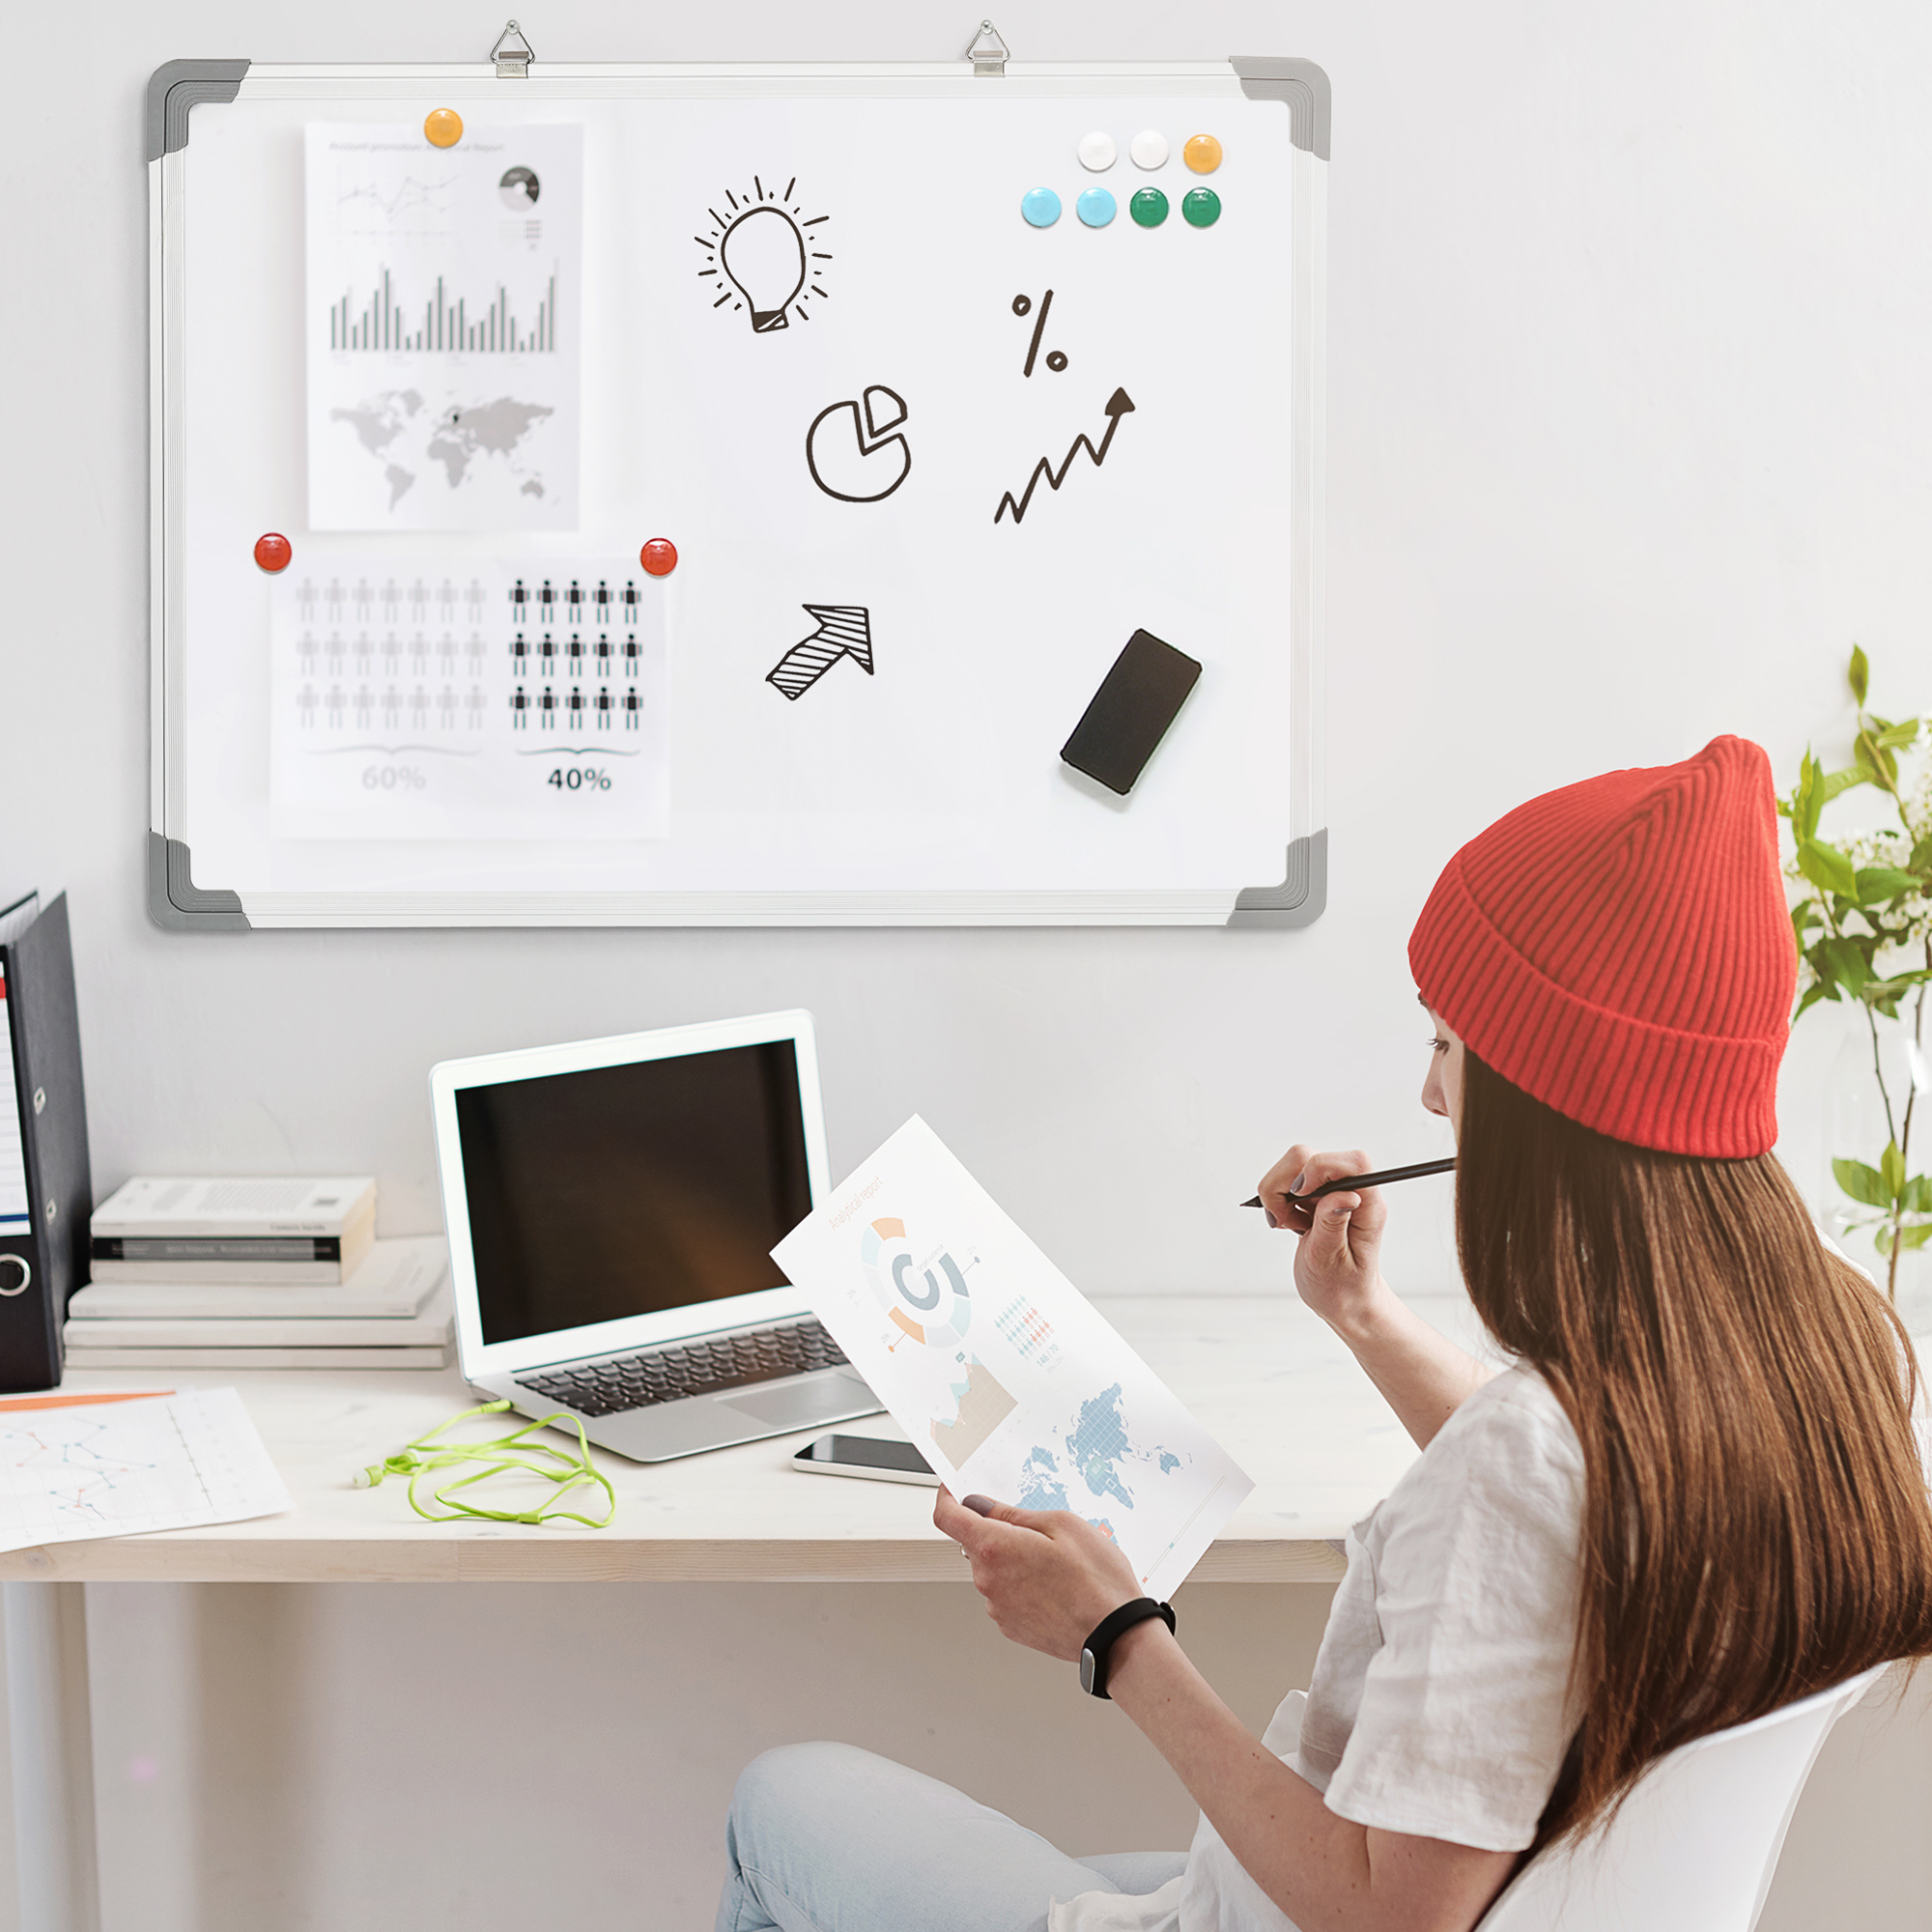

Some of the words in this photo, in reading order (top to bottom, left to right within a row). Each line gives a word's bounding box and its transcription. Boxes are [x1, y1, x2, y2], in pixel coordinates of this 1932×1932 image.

[361, 767, 426, 790] 60%
[548, 769, 611, 790] 40%
[828, 1195, 864, 1232] Analytical
[860, 1176, 884, 1202] report
